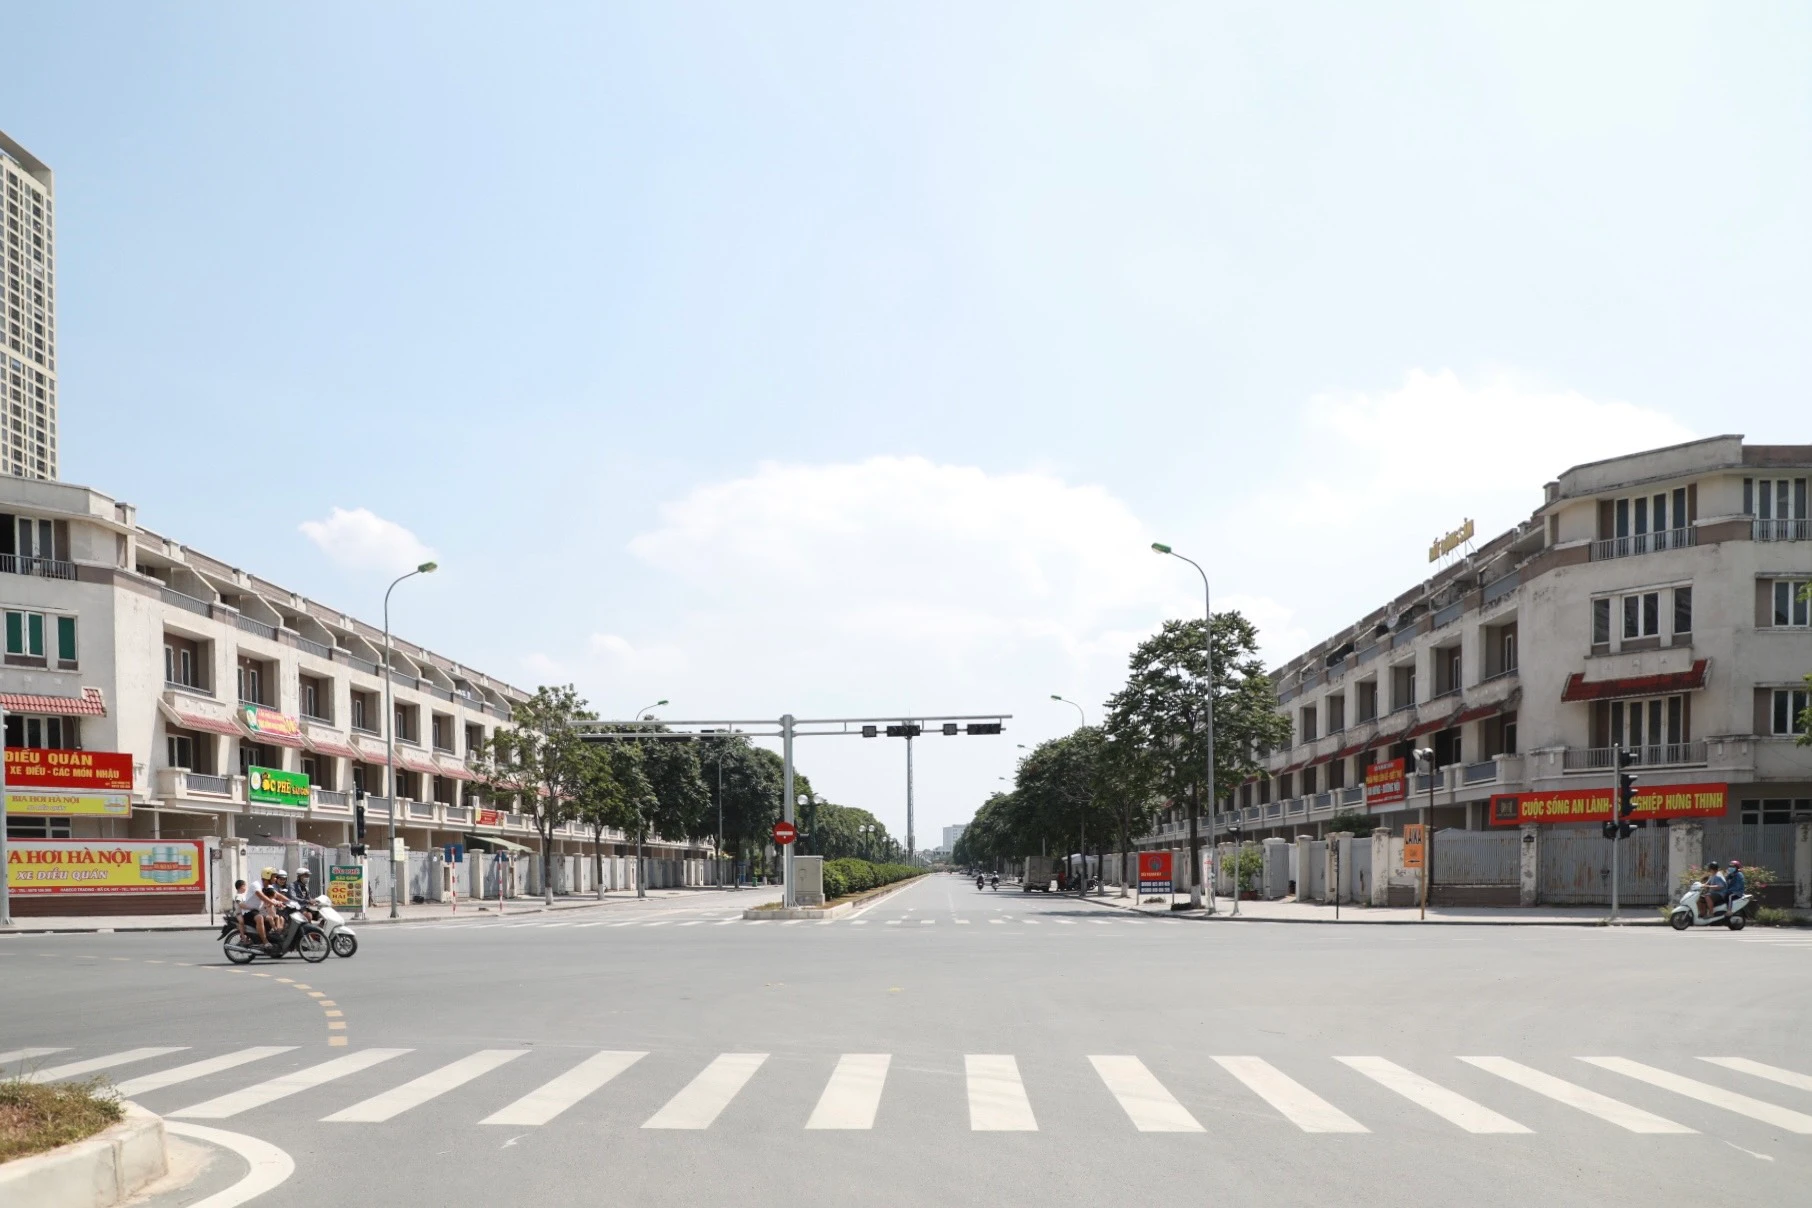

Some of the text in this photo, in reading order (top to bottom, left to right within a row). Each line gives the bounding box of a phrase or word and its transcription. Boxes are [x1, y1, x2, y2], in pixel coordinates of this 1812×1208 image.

[48, 751, 93, 766] QUÁN
[10, 766, 22, 775] XE
[53, 765, 70, 777] CÁC
[73, 767, 93, 778] MÓN
[96, 768, 120, 781] NHẬU
[12, 795, 80, 804] BIA HƠI HÀ NỘI
[1522, 798, 1545, 818] CUỘC
[1546, 795, 1569, 815] SỐNG
[1572, 799, 1584, 813] AN
[1665, 793, 1692, 810] HƯNG
[1695, 793, 1723, 812] THỊNH
[26, 850, 63, 864] HƠI
[67, 846, 96, 864] HÀ
[97, 847, 132, 868] NỘI
[16, 870, 34, 880] XE
[72, 868, 108, 881] QUÁN
